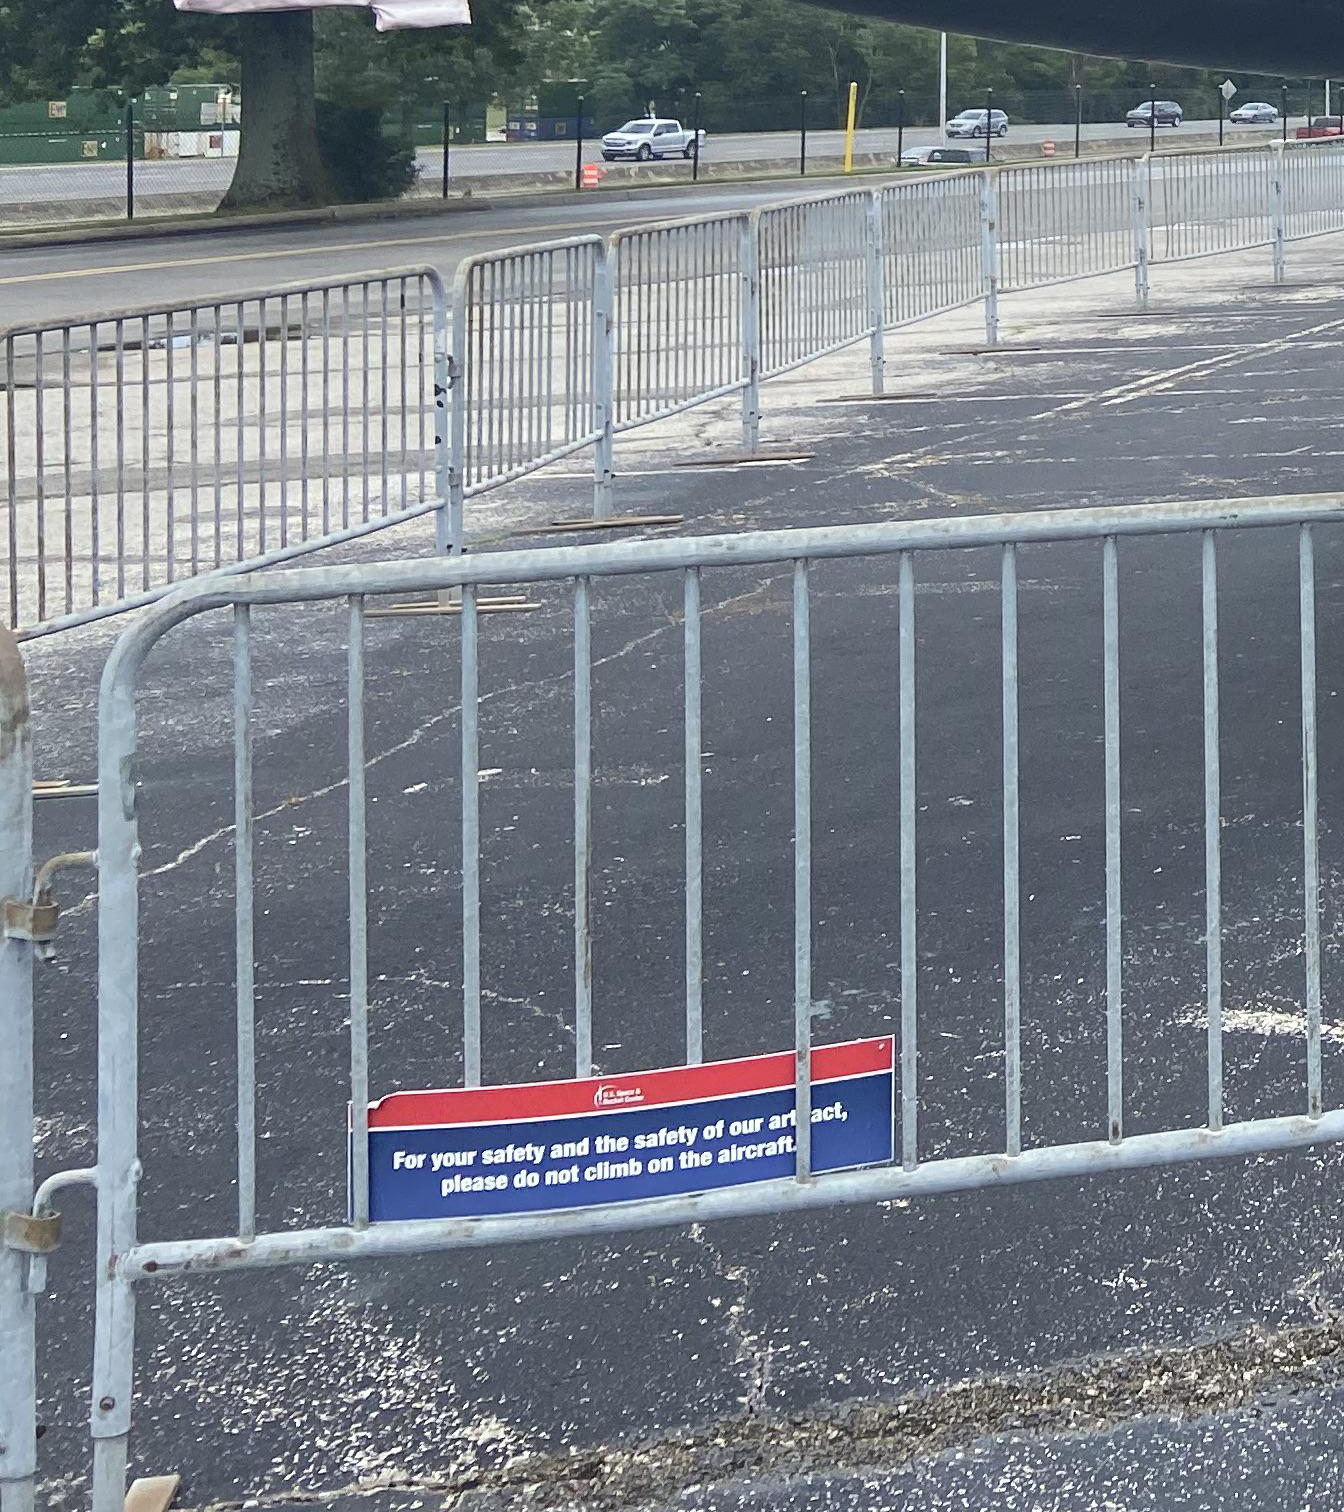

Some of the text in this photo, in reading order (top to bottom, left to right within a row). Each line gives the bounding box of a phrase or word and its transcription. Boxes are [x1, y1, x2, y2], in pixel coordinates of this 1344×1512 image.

[393, 1101, 848, 1172] For your safety and the safety of our artact,
[441, 1135, 797, 1197] please do not climb on the aircraft.
